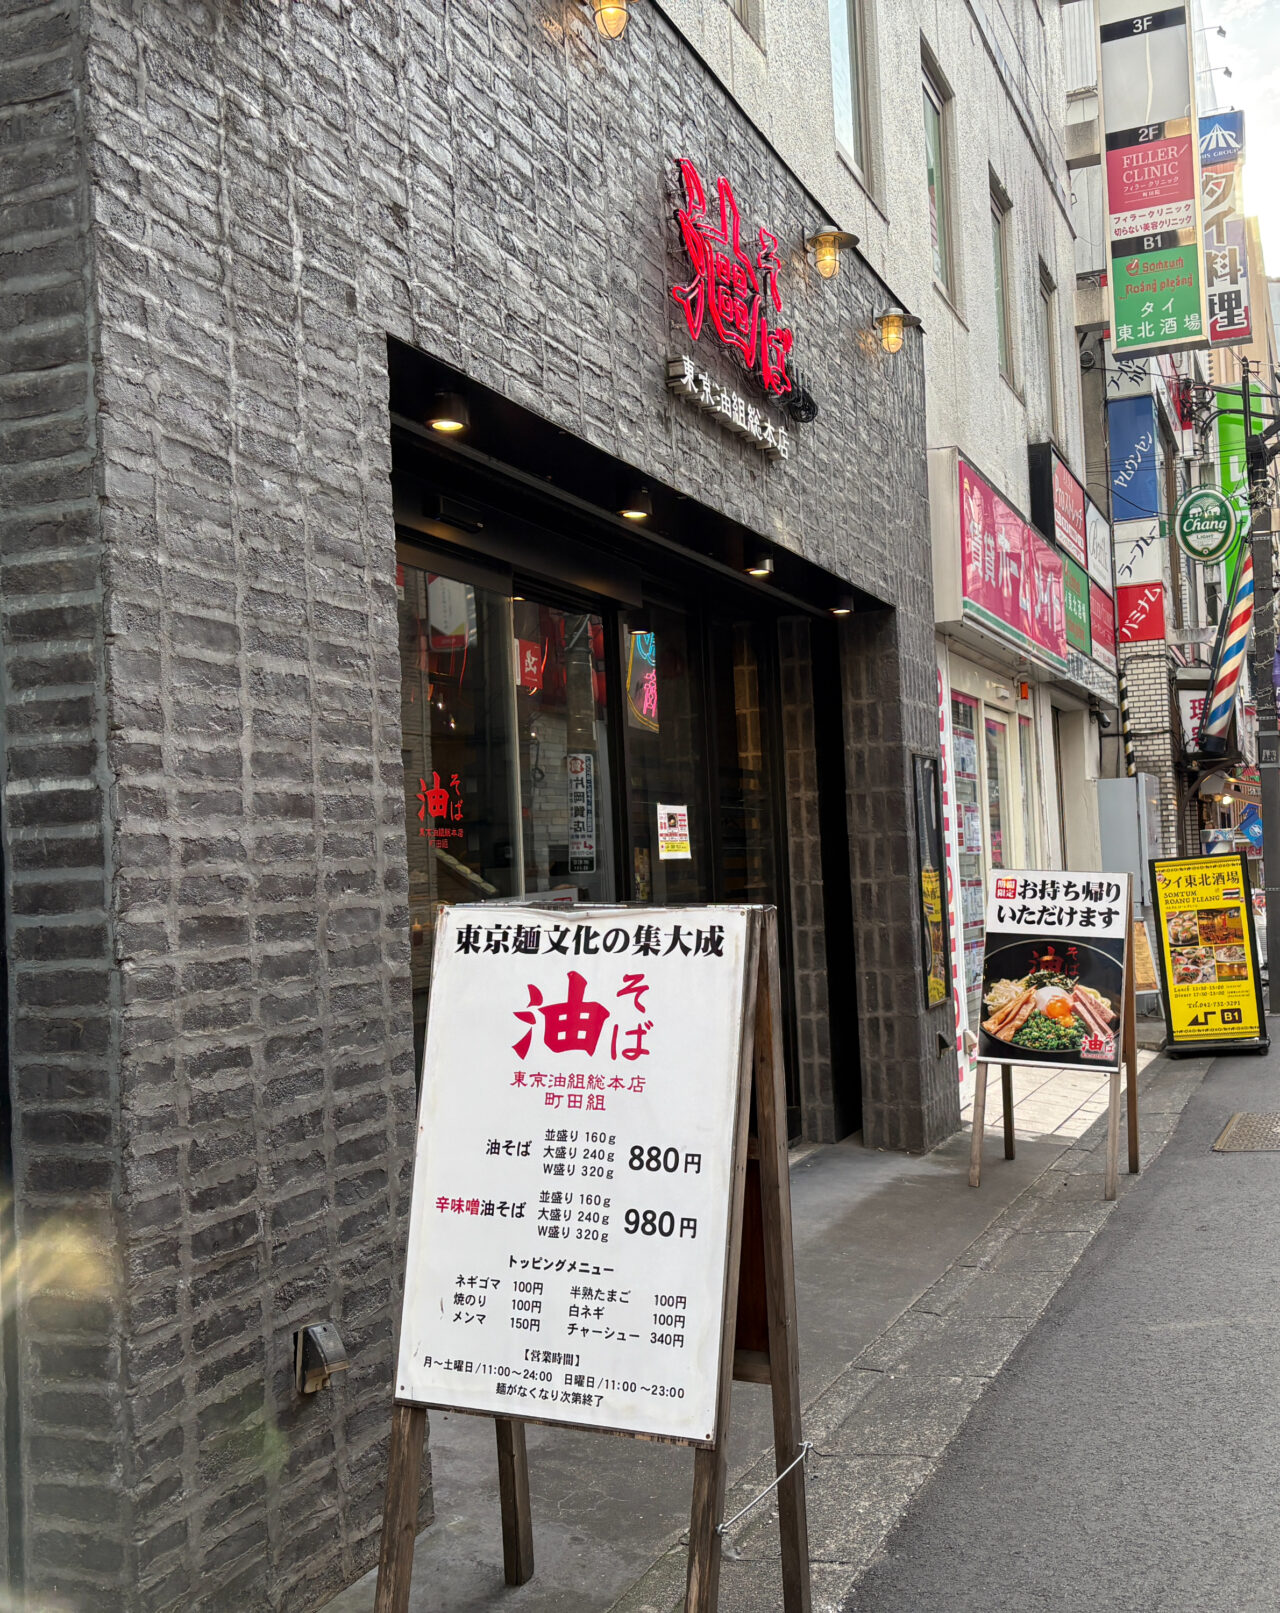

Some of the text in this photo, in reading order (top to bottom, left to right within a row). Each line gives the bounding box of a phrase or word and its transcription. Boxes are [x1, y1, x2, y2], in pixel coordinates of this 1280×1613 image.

[1133, 17, 1153, 33] 3F
[1138, 125, 1159, 142] 2F
[1123, 146, 1178, 168] FILLER
[1122, 161, 1179, 184] CLINIC
[1113, 203, 1191, 225] フィラークリニック
[1113, 215, 1192, 237] 切らない美容クリニック
[1143, 234, 1162, 250] B1
[1203, 173, 1247, 330] タイ料理
[1141, 297, 1174, 318] タイ
[1117, 313, 1201, 342] 東北酒場
[680, 354, 789, 460] 東京油組総本店
[1114, 431, 1153, 488] ヤムウンセン
[1183, 518, 1228, 533] Chang
[1121, 588, 1161, 639] バミナム
[416, 770, 464, 824] 油そば
[1018, 879, 1121, 903] お持ち帰り
[1161, 871, 1240, 889] タイ東北酒場
[1163, 890, 1197, 899] SOMTUM
[997, 904, 1120, 929] いただけます
[454, 923, 725, 957] 東京麺文化の集大成
[511, 970, 655, 1061] 油そば
[1224, 1011, 1239, 1021] B1
[510, 1070, 647, 1094] 東京油組総本店
[544, 1092, 607, 1111] 町田組
[485, 1138, 533, 1157] 油そば
[544, 1128, 617, 1145] 並盛り 160g
[543, 1145, 615, 1162] 大盛り 240g
[628, 1144, 702, 1175] 880円
[542, 1162, 614, 1180] W盛り 320g
[435, 1195, 527, 1219] 辛味噌油そば
[539, 1189, 611, 1208] 並盛り 160g
[537, 1207, 610, 1225] 大盛り 240g
[623, 1207, 698, 1239] 980円
[537, 1224, 609, 1243] W盛り 320g
[508, 1254, 615, 1276] トッピングメニュー
[455, 1273, 544, 1296] ネギゴマ 100円
[453, 1292, 542, 1314] 焼のり 100円
[569, 1285, 687, 1310] 半熟たまご 100円
[452, 1311, 541, 1333] メンマ 150円
[568, 1303, 686, 1329] 白ネギ 100円
[567, 1322, 685, 1349] チャーシュー 340円
[495, 1381, 605, 1408] 麺がなくなり次第終了
